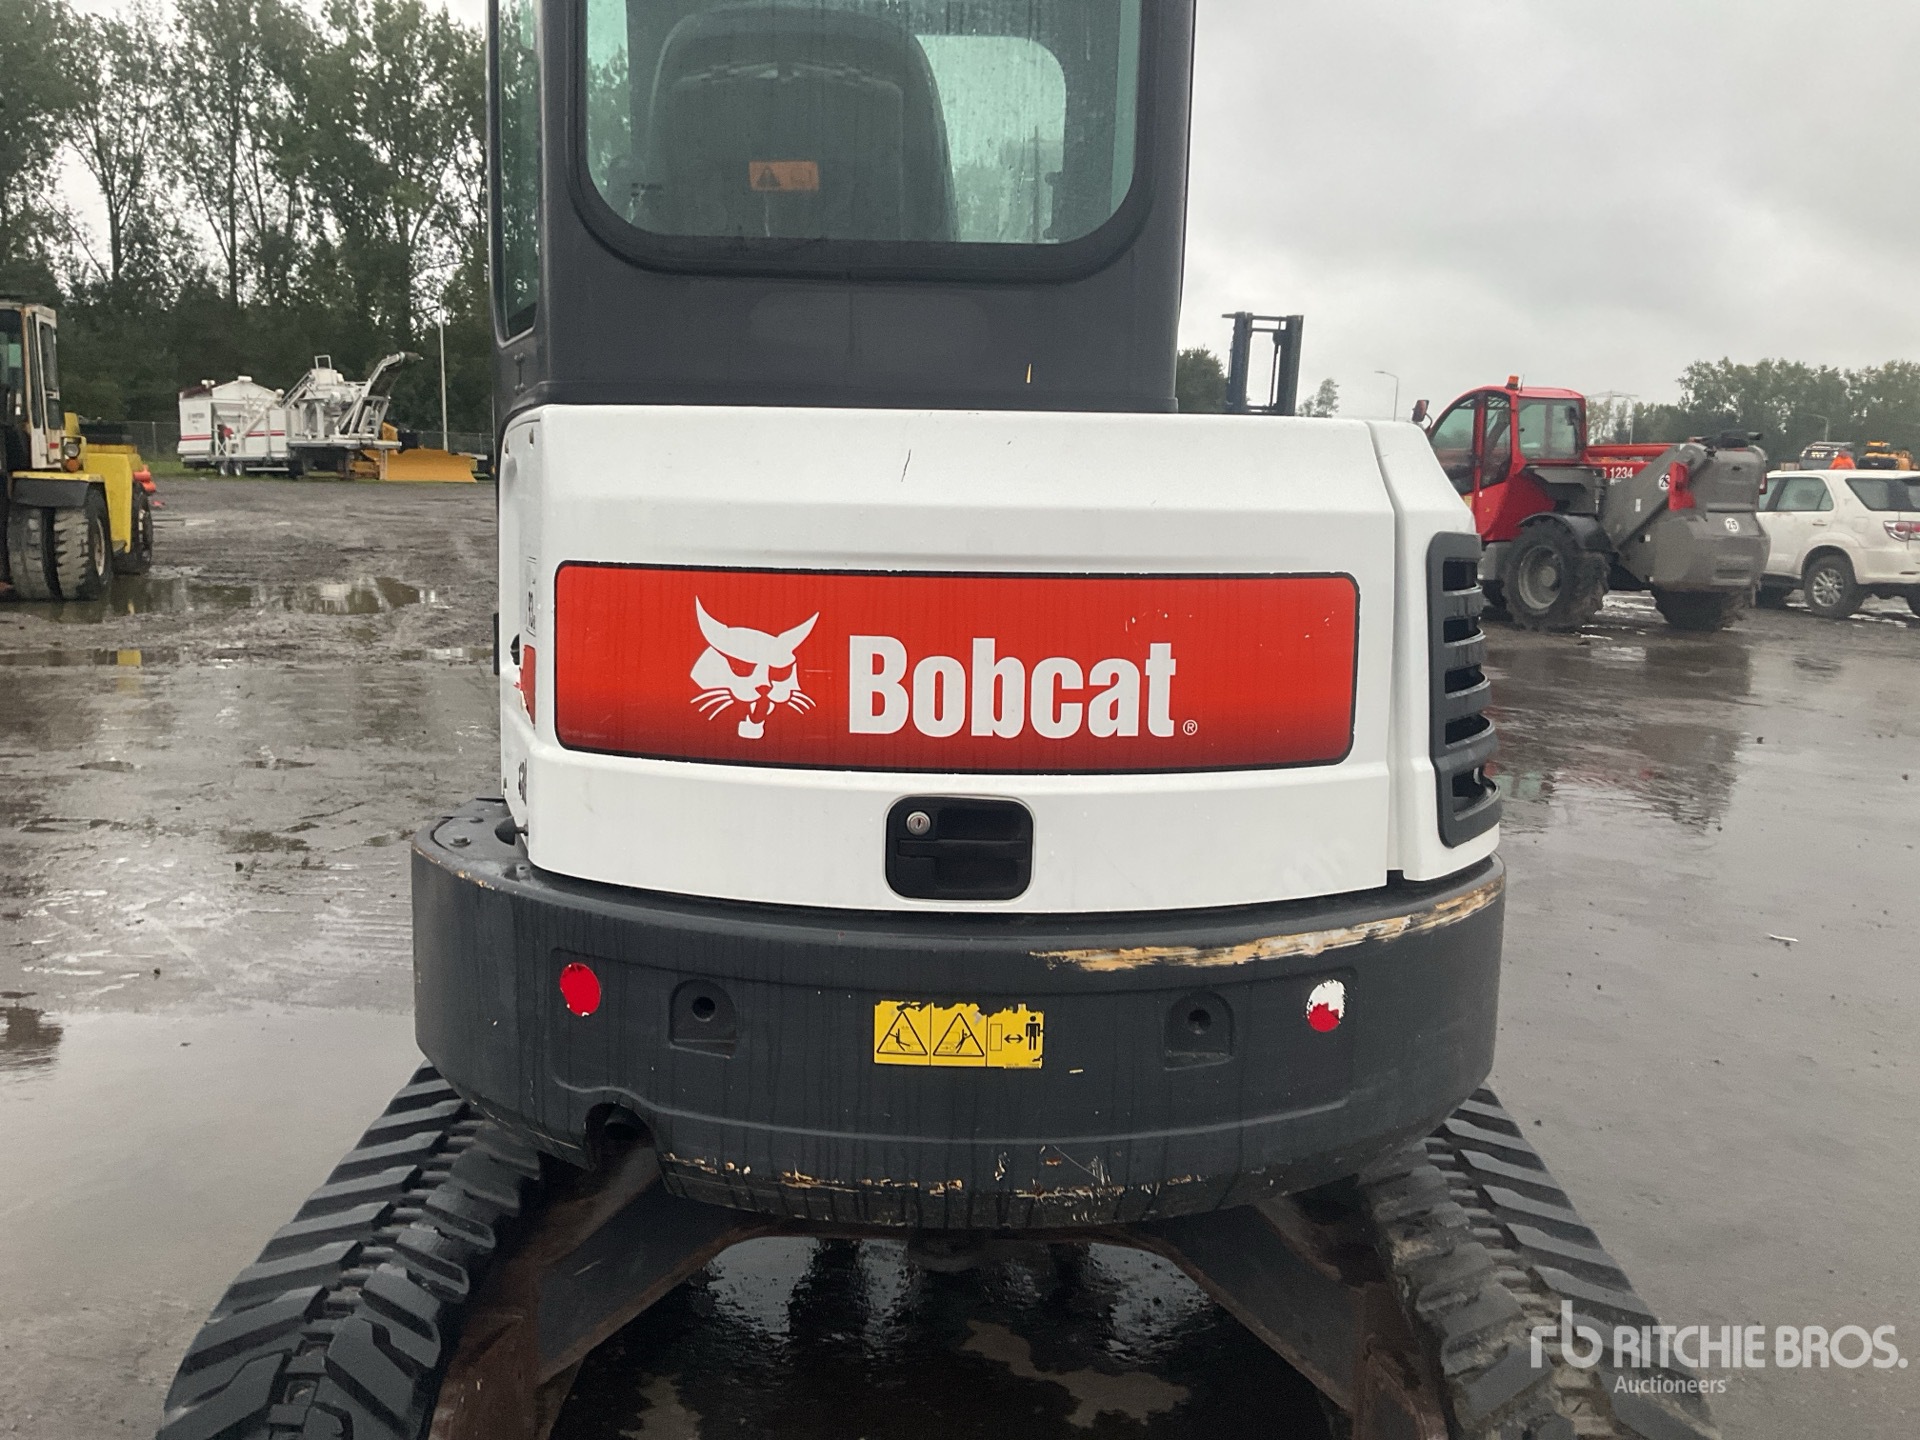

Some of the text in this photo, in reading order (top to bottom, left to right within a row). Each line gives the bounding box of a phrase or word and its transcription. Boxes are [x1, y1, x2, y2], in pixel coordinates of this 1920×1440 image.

[1609, 466, 1634, 479] 1234
[1726, 520, 1738, 530] 25
[849, 635, 1177, 739] Bobcat
